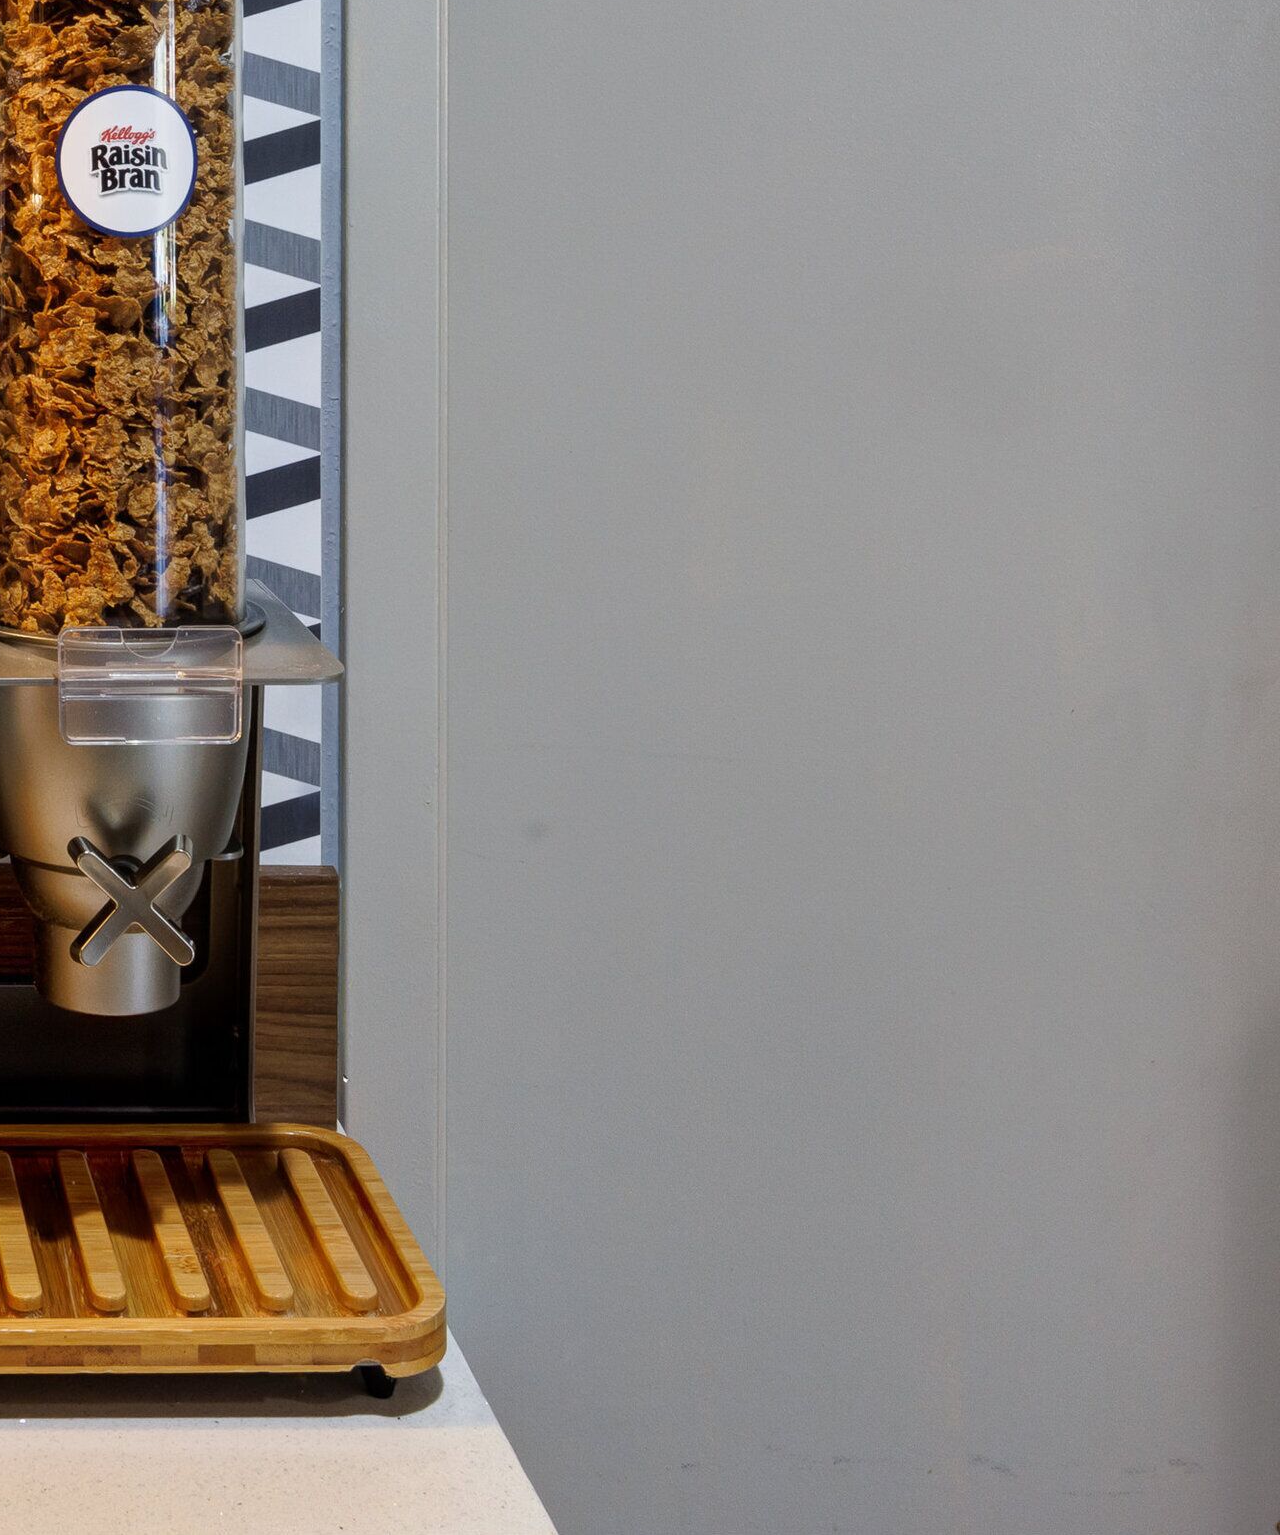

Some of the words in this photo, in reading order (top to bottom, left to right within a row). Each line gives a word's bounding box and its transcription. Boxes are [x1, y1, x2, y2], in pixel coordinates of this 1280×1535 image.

[101, 126, 155, 144] Kellogg's
[92, 145, 167, 171] Raisin
[101, 167, 161, 193] Bran
